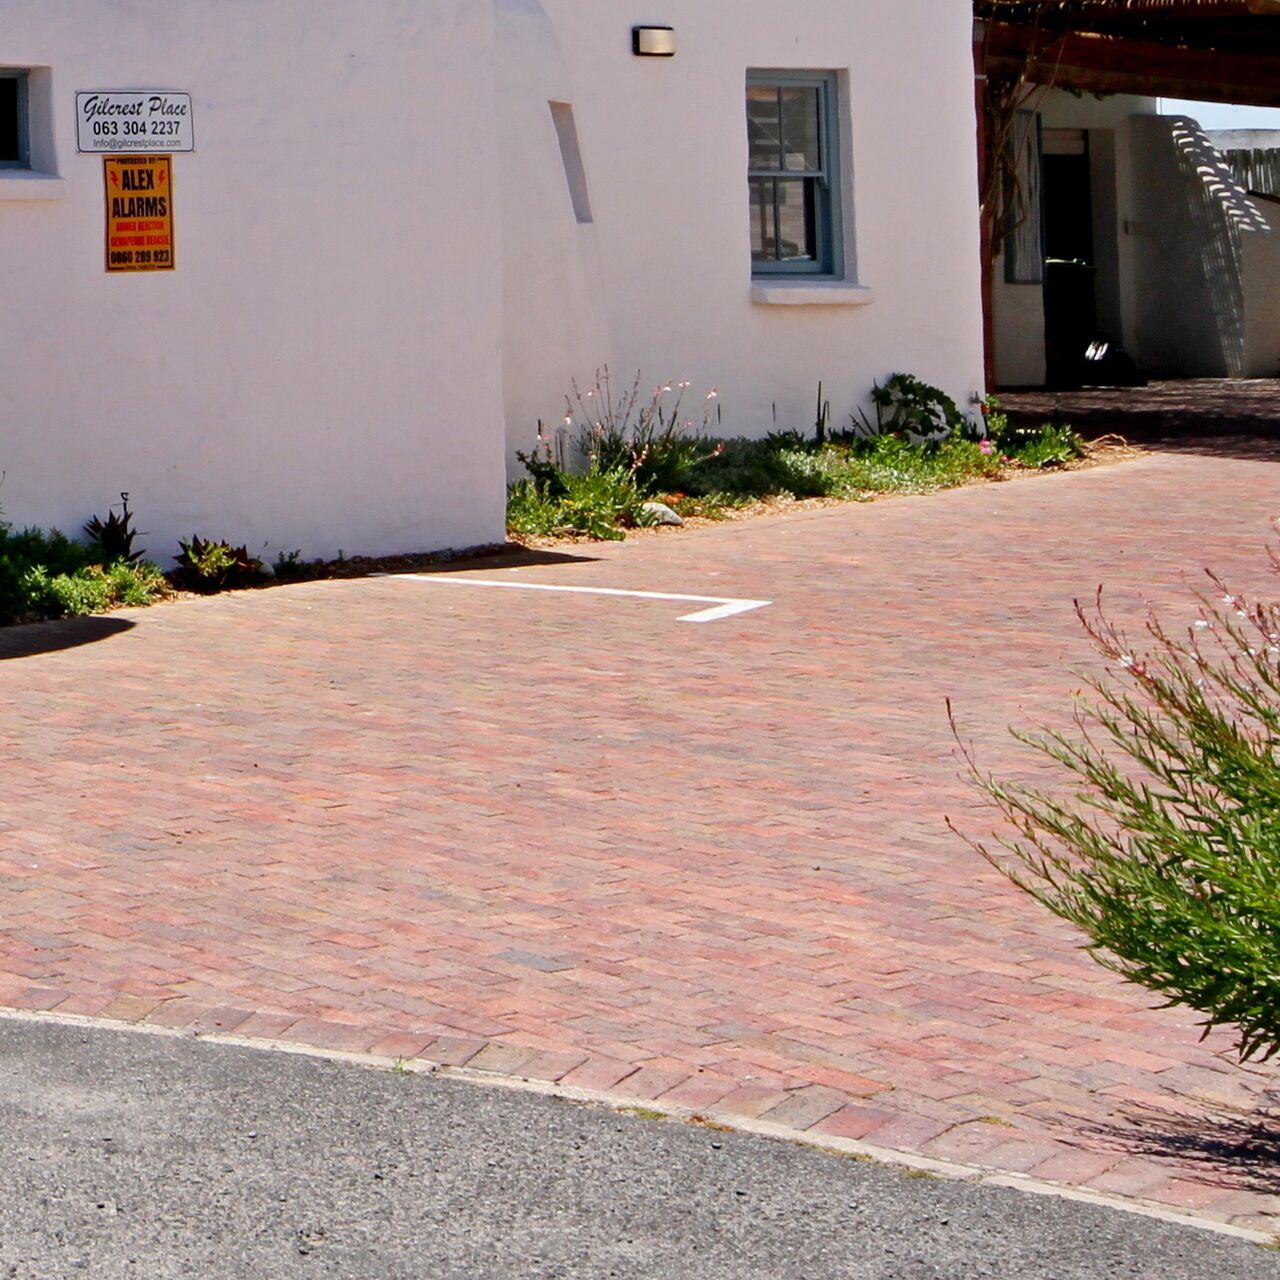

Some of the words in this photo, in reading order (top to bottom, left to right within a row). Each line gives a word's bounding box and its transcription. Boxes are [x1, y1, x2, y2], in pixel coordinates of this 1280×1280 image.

[84, 95, 143, 122] Gilcrest
[148, 96, 187, 117] Place
[93, 121, 118, 135] 063
[123, 121, 147, 135] 304
[151, 121, 181, 135] 2237
[122, 169, 155, 191] ALEX
[112, 196, 167, 219] ALARMS
[153, 249, 170, 262] 923
